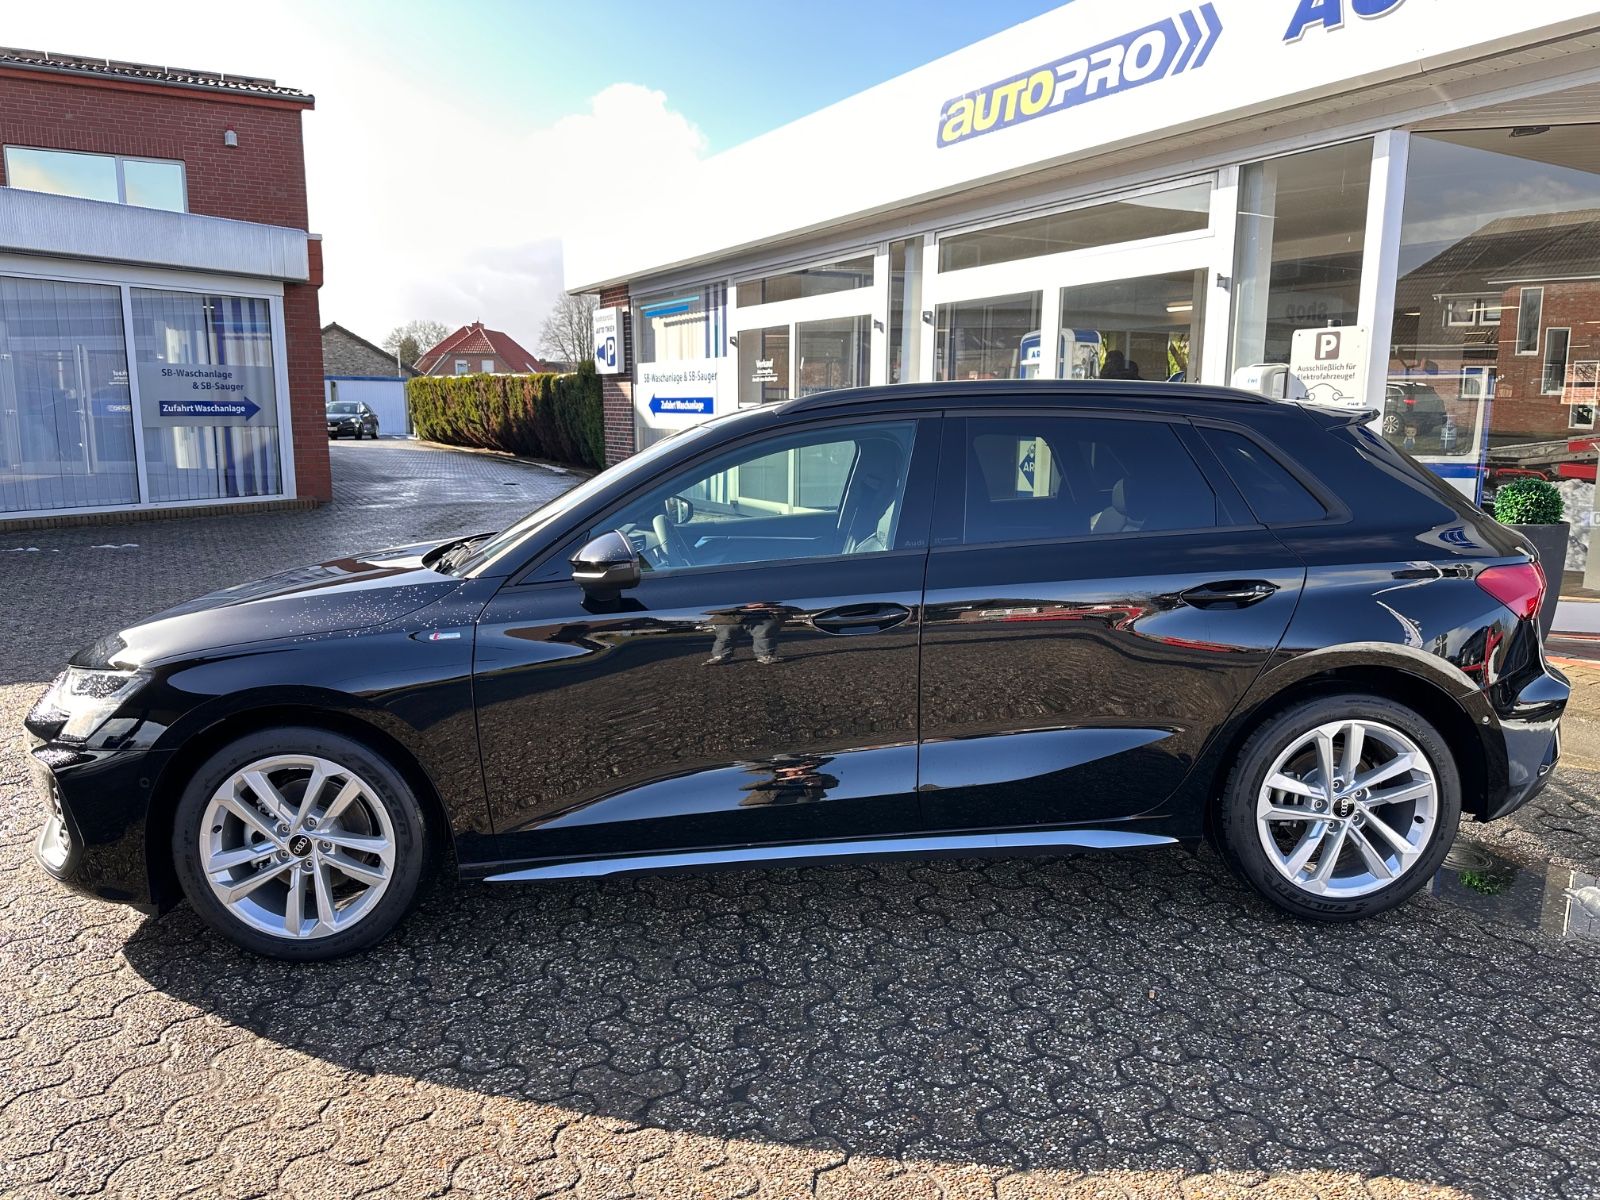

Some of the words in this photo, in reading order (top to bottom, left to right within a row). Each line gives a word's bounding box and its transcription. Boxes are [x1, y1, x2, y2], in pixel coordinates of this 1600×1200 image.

[1319, 334, 1338, 359] P
[1296, 363, 1345, 372] Ausschließlich
[1345, 362, 1357, 371] für
[161, 368, 233, 380] SB-Waschanlage
[643, 372, 683, 384] SB-Waschanlage
[683, 371, 688, 382] &
[688, 369, 718, 384] SB-Sauger
[192, 382, 199, 390] &
[200, 381, 244, 392] SB-Sauger
[162, 404, 194, 412] Zufahrt
[195, 404, 246, 414] Waschanlage
